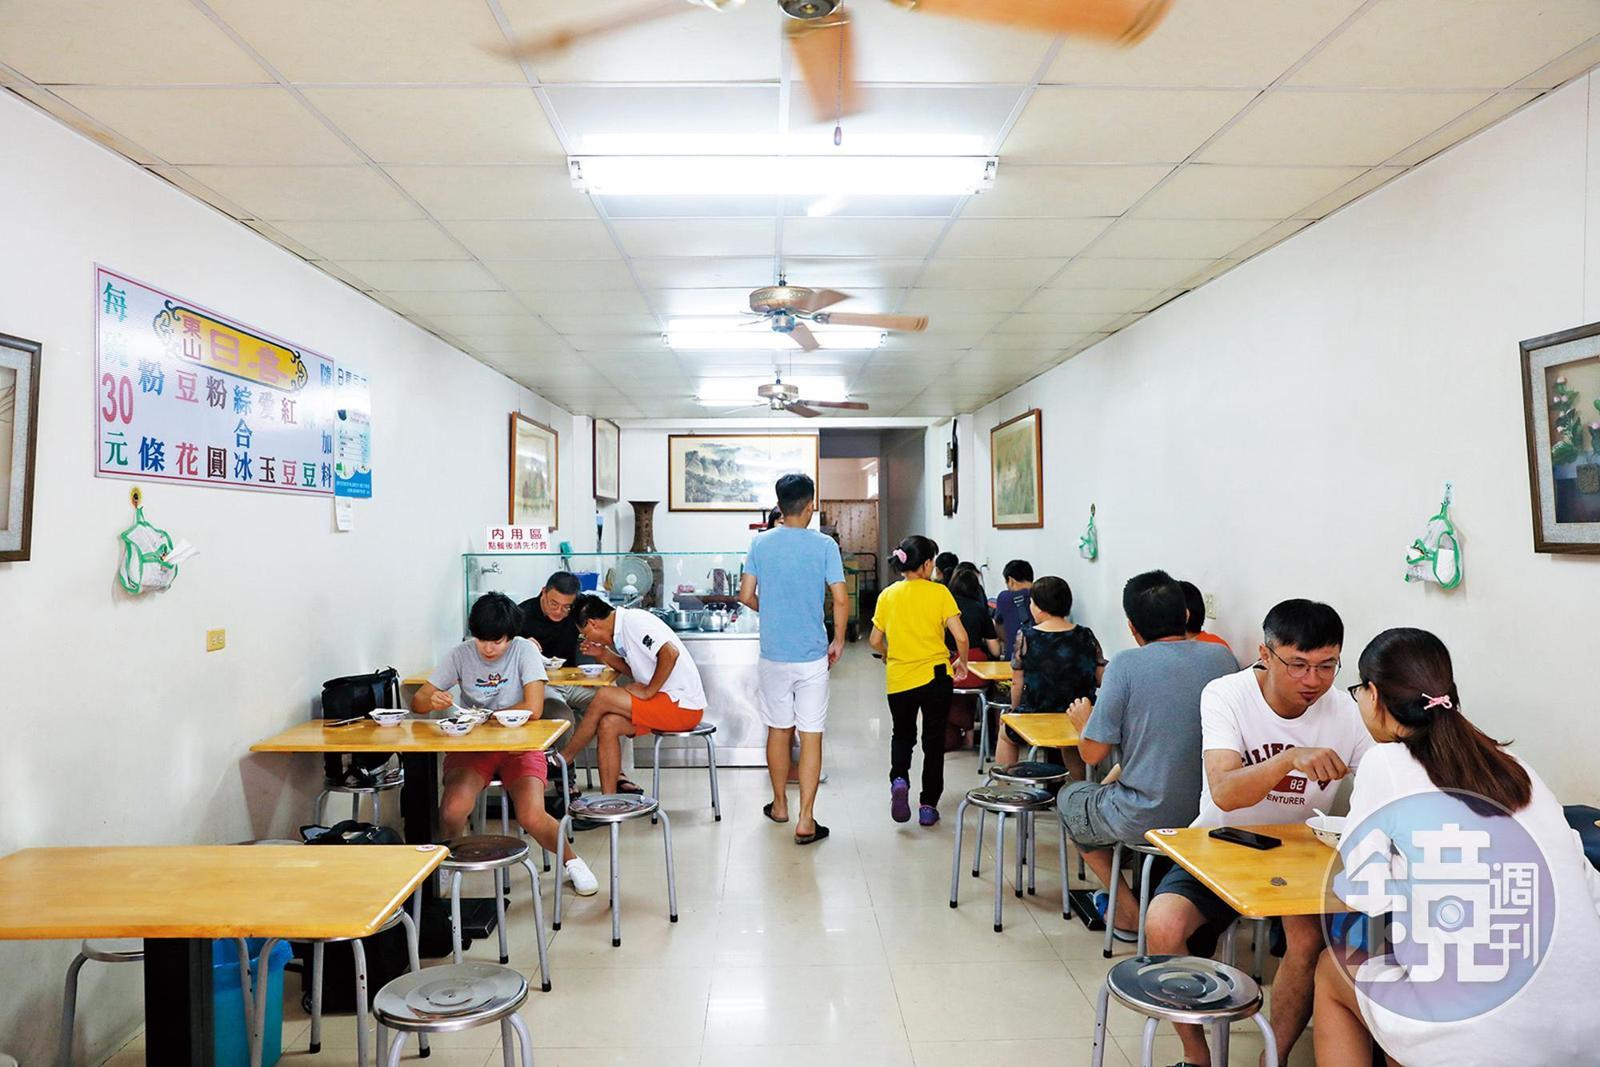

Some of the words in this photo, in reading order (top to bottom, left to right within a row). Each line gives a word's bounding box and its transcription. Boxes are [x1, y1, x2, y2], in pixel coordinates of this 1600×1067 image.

[175, 369, 199, 476] 豆花
[206, 375, 228, 480] 粉圓
[233, 384, 253, 482] 綜合冰
[281, 397, 297, 486] 紅豆
[1290, 778, 1305, 791] 82
